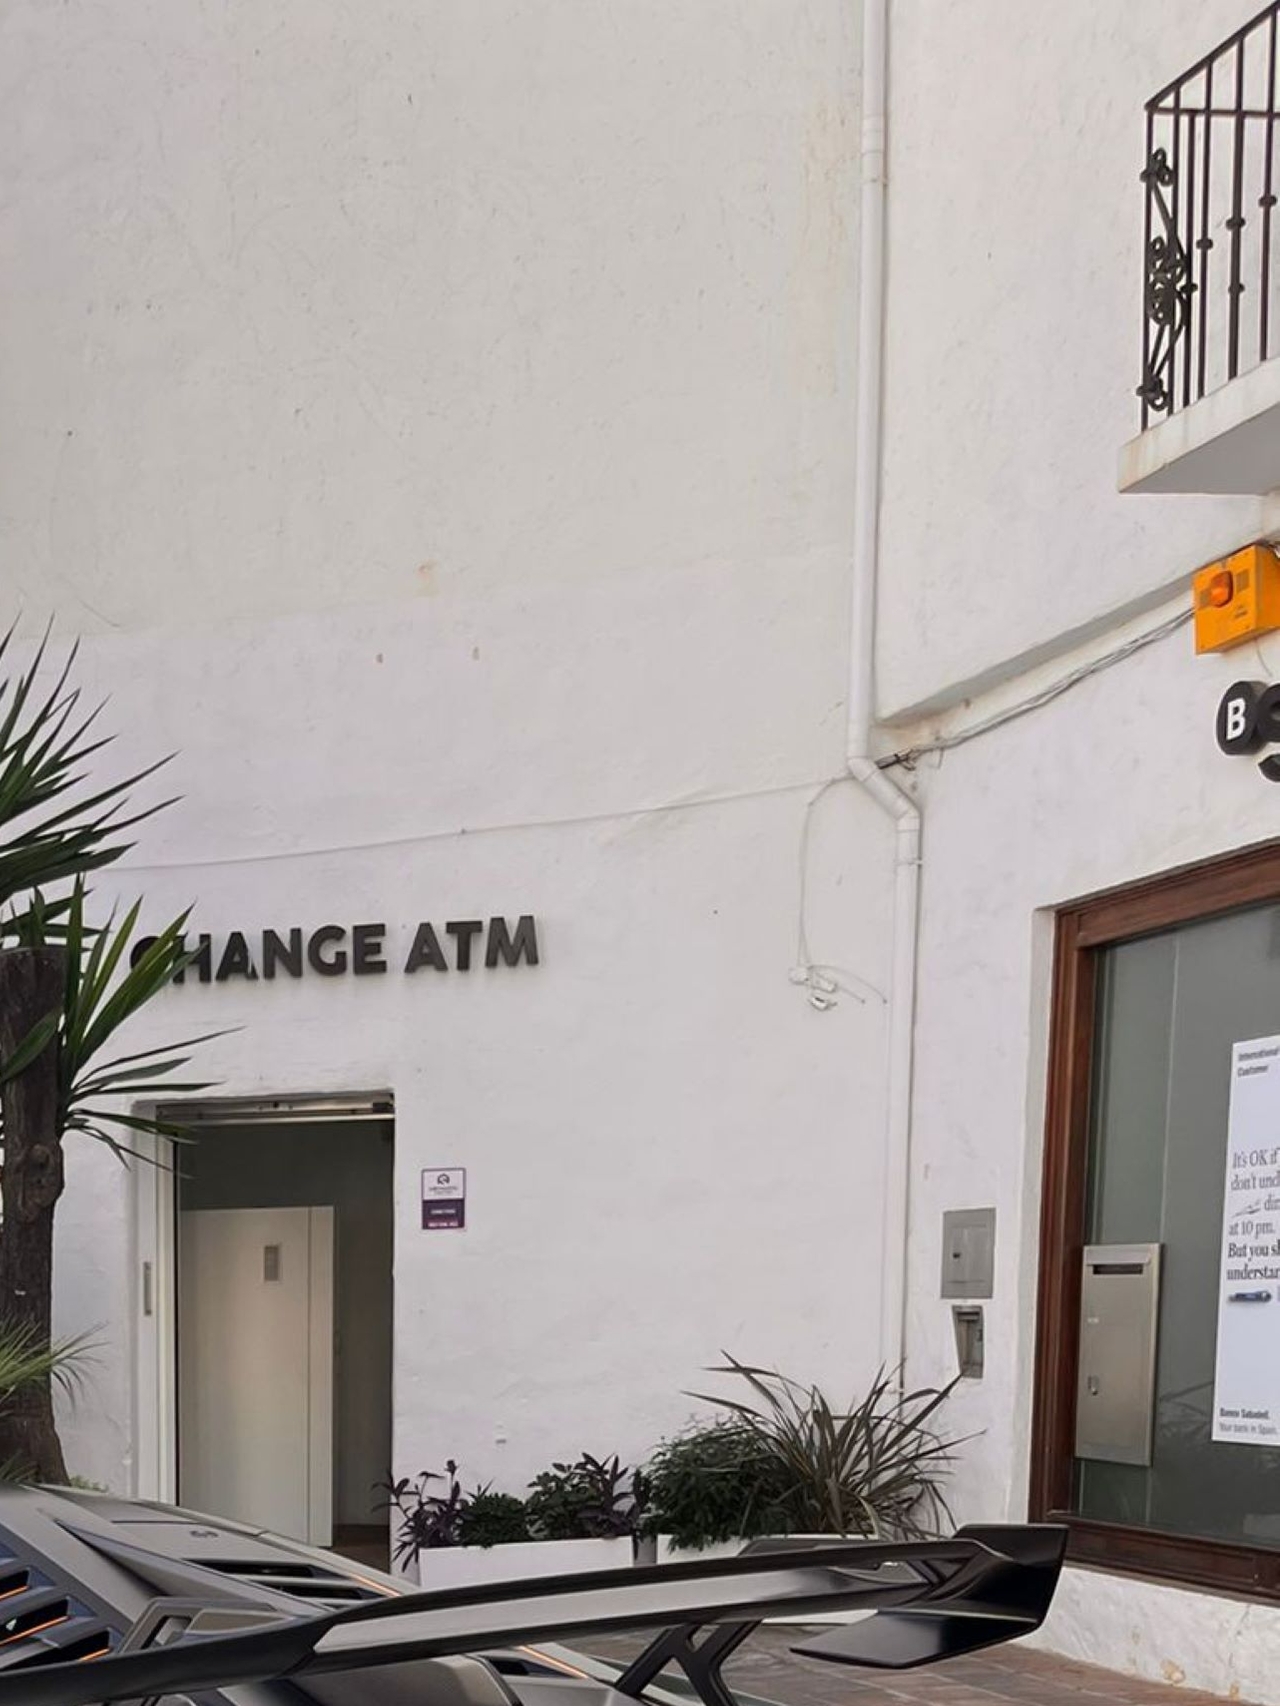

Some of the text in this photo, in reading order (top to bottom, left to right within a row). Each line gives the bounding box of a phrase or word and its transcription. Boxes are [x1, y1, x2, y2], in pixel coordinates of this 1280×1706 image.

[1226, 698, 1246, 741] B
[405, 915, 539, 974] ATM
[1249, 1149, 1267, 1167] OK
[1242, 1221, 1253, 1235] 10
[1228, 1242, 1246, 1258] But
[1249, 1246, 1269, 1262] you
